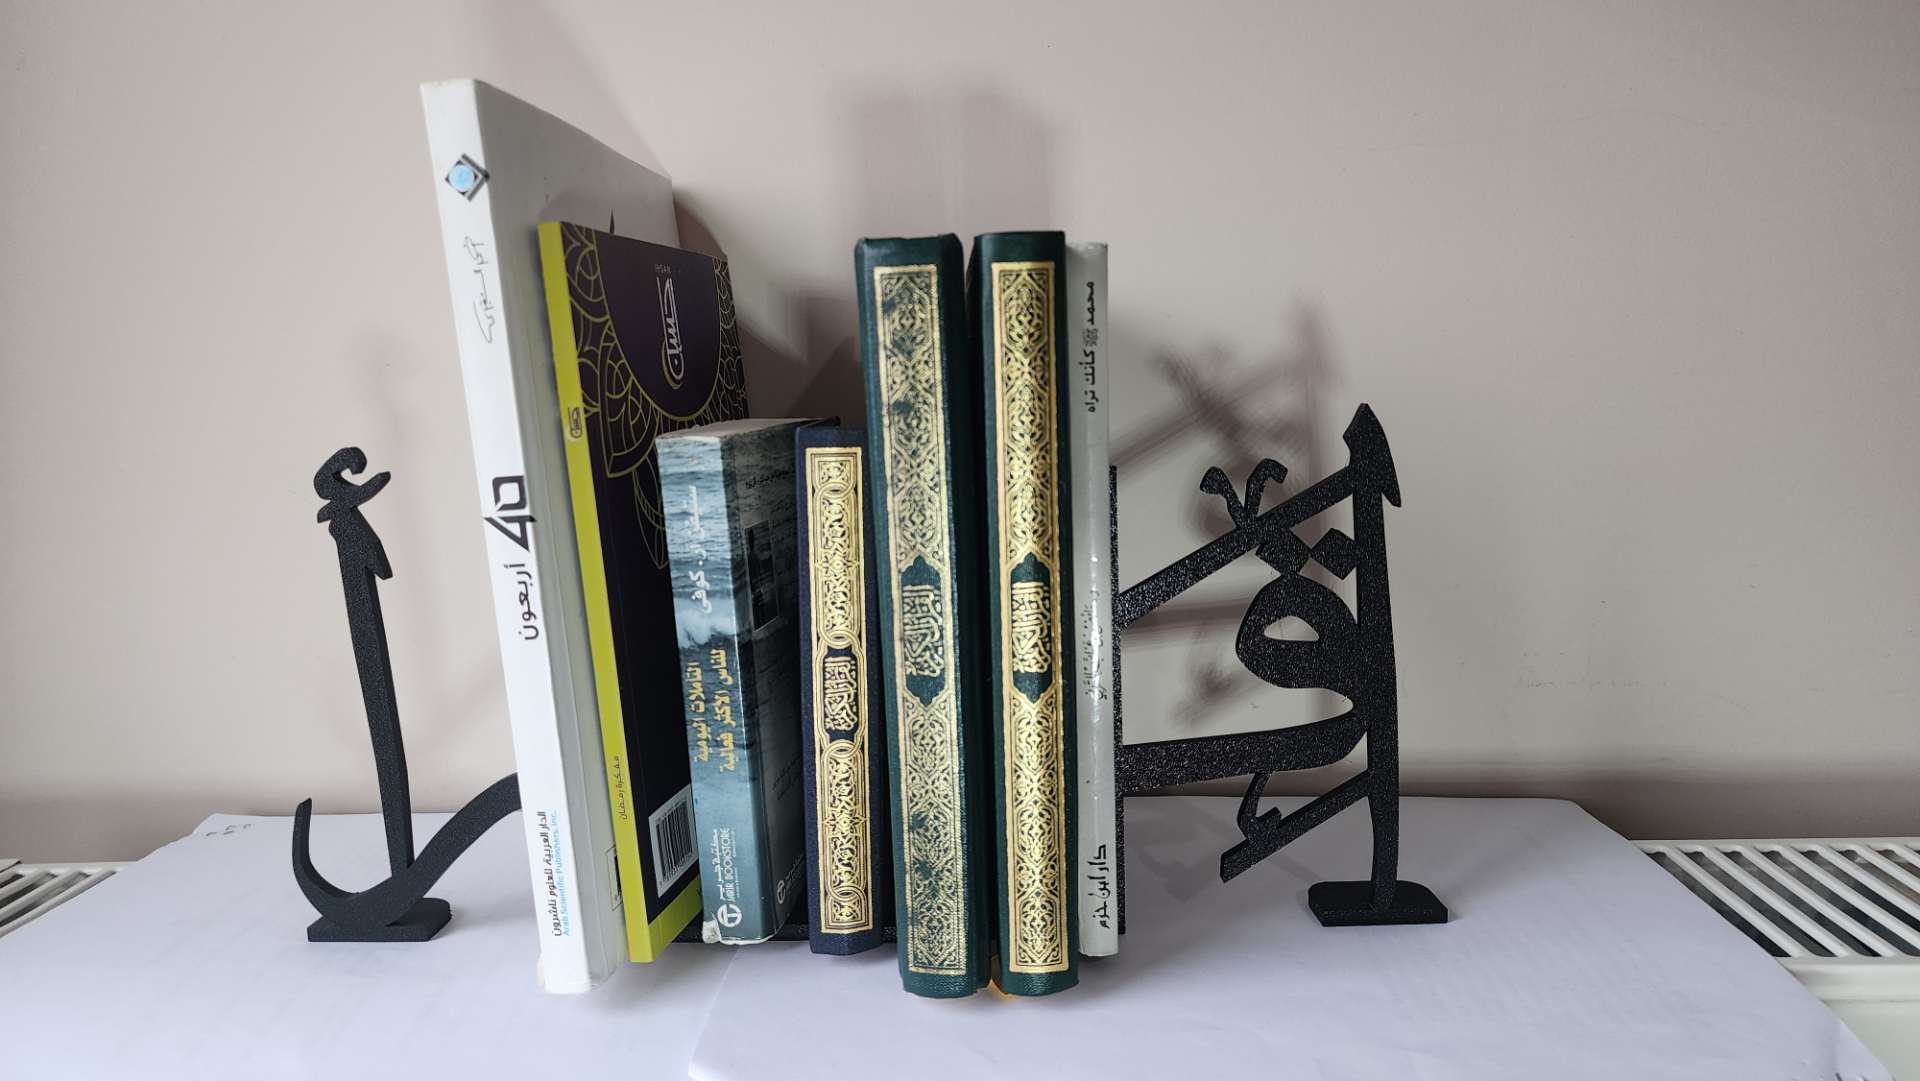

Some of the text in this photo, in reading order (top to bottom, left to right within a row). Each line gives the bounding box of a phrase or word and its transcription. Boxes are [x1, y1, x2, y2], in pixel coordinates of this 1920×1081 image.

[1086, 281, 1095, 325] محمد
[1079, 349, 1095, 385] كأنك
[1084, 390, 1099, 412] تراه
[483, 475, 537, 552] 40
[683, 486, 706, 539] ستيفن
[503, 563, 539, 641] أربعون
[710, 649, 733, 685] للناس
[691, 718, 712, 762] اليومية
[716, 732, 739, 772] فعالية
[613, 756, 627, 819] مفكرة رمضان
[550, 811, 558, 826] Inc.
[538, 812, 562, 936] الدار العربية للعلوم ناشرون
[710, 828, 726, 901] مكتبة جرير
[720, 828, 734, 880] BOOKSTORE
[557, 876, 568, 914] Scientific
[725, 883, 736, 902] JARIR
[1087, 844, 1110, 929] دار ابن حزم
[561, 917, 570, 936] Arab
